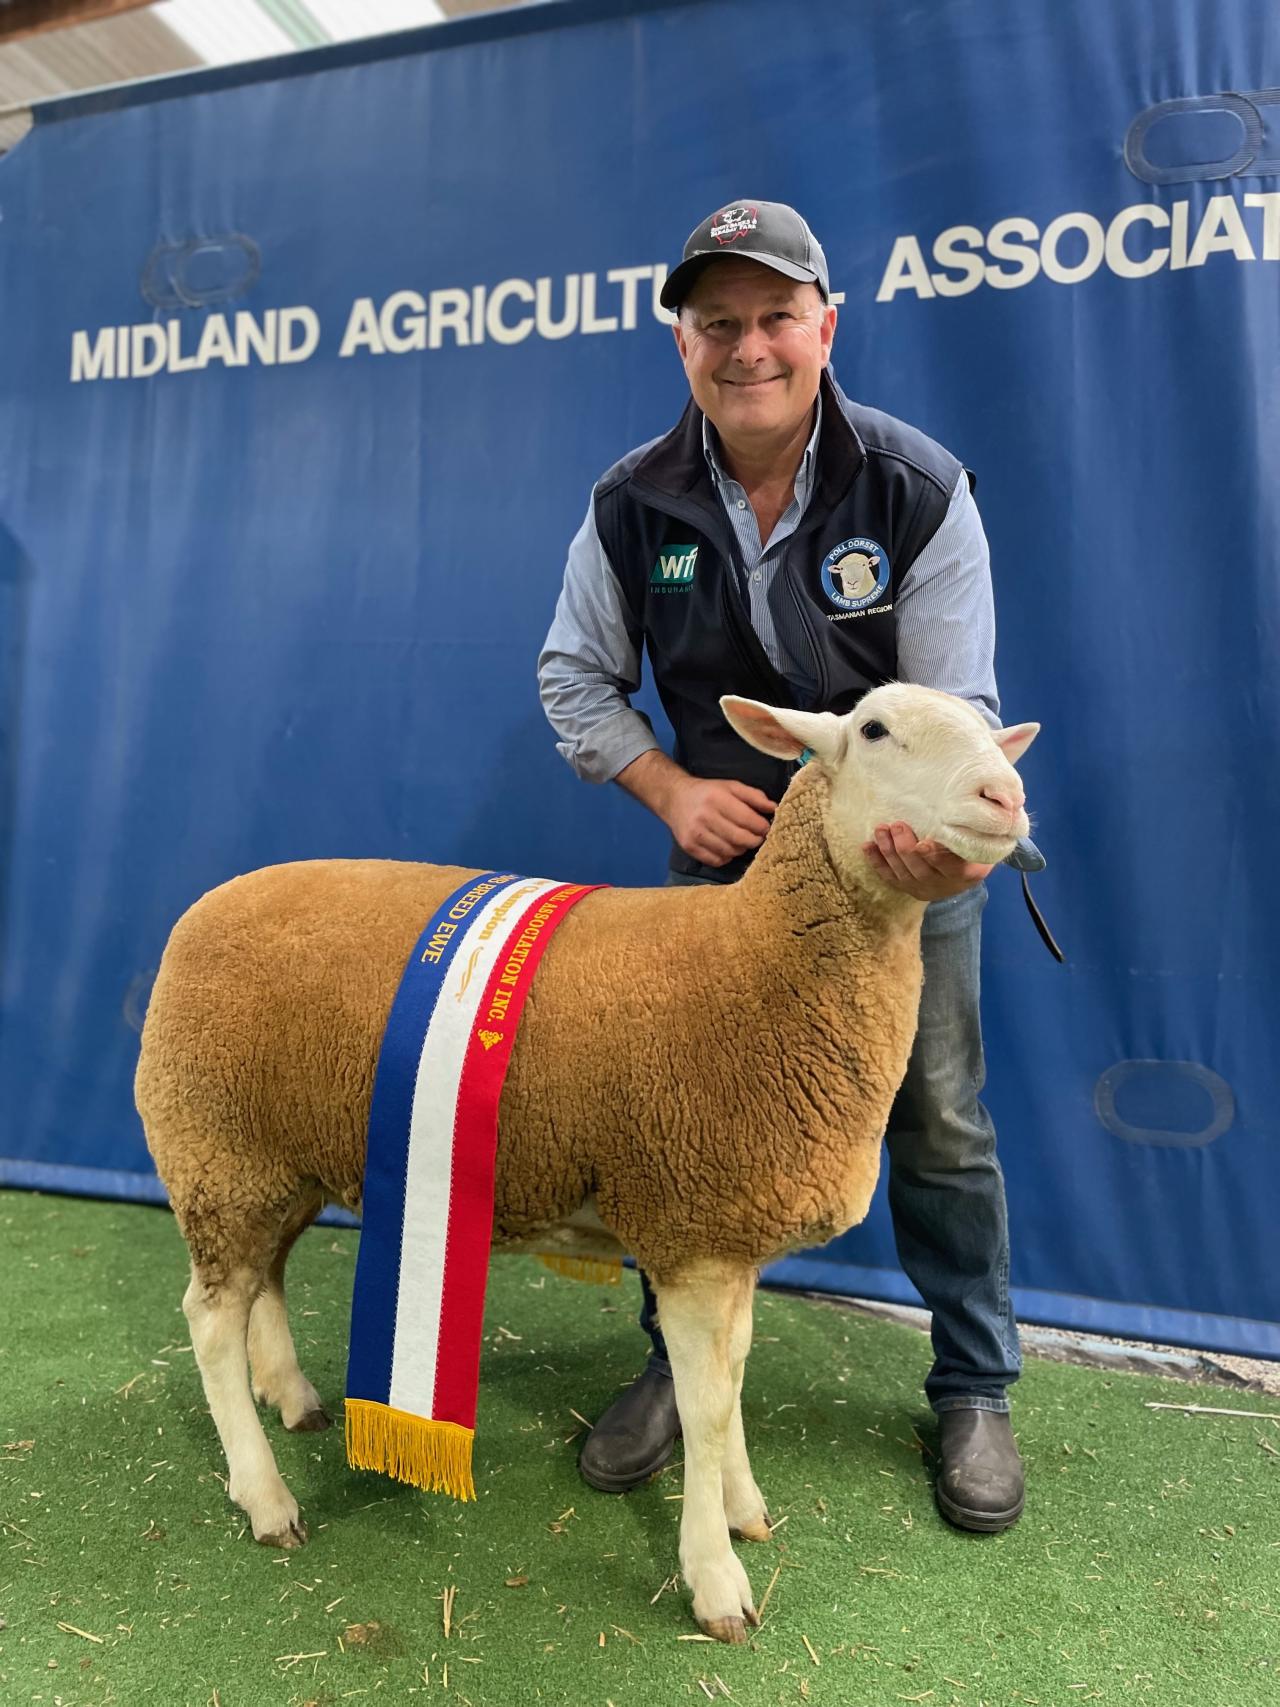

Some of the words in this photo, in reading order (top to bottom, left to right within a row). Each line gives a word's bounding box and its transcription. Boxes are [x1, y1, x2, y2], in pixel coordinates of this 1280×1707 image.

[71, 306, 319, 381] MIDLAND
[340, 264, 845, 356] AGRICULTU
[877, 192, 1280, 301] ASSOCIAT
[829, 544, 848, 561] POLL
[848, 540, 880, 553] DORSET
[826, 609, 866, 622] TASMANIAN
[867, 604, 893, 615] REGION
[831, 592, 851, 607] LAMB
[851, 584, 884, 607] SUPREME
[448, 882, 497, 920] BREED
[421, 921, 458, 965] EWE
[500, 902, 558, 987] ASSOCIATION
[486, 989, 513, 1023] INC.
